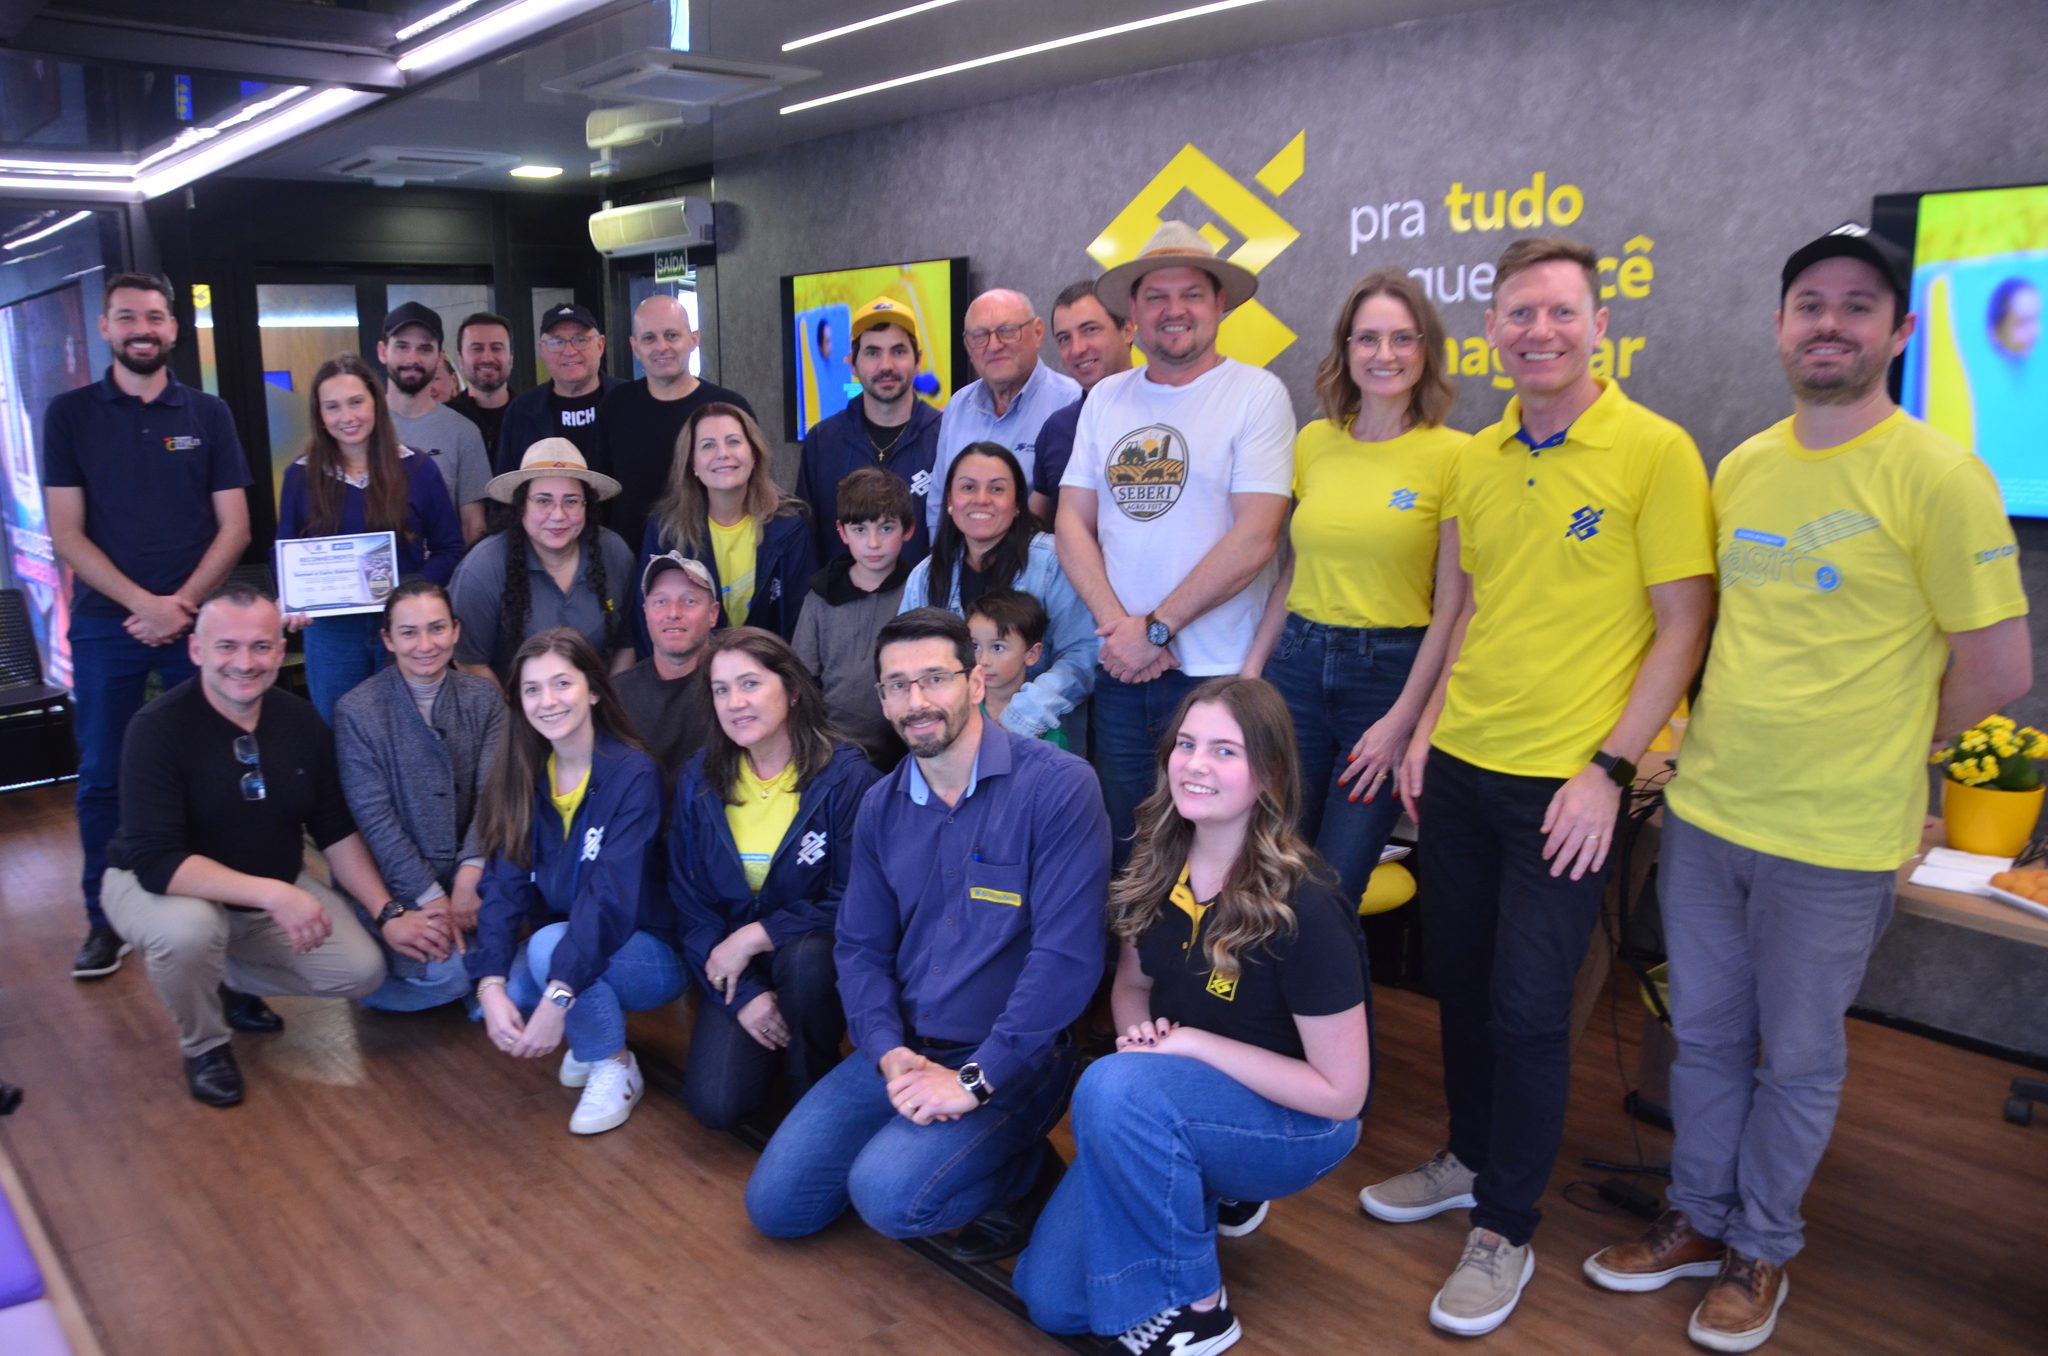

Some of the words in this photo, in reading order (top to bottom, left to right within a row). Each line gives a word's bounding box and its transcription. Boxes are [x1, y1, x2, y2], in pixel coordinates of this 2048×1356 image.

[1351, 199, 1426, 256] pra
[1444, 171, 1585, 233] tudo
[657, 250, 686, 274] SAÍDA
[1595, 234, 1656, 300] cê
[561, 406, 596, 427] RICH
[1118, 486, 1173, 500] SEBERI
